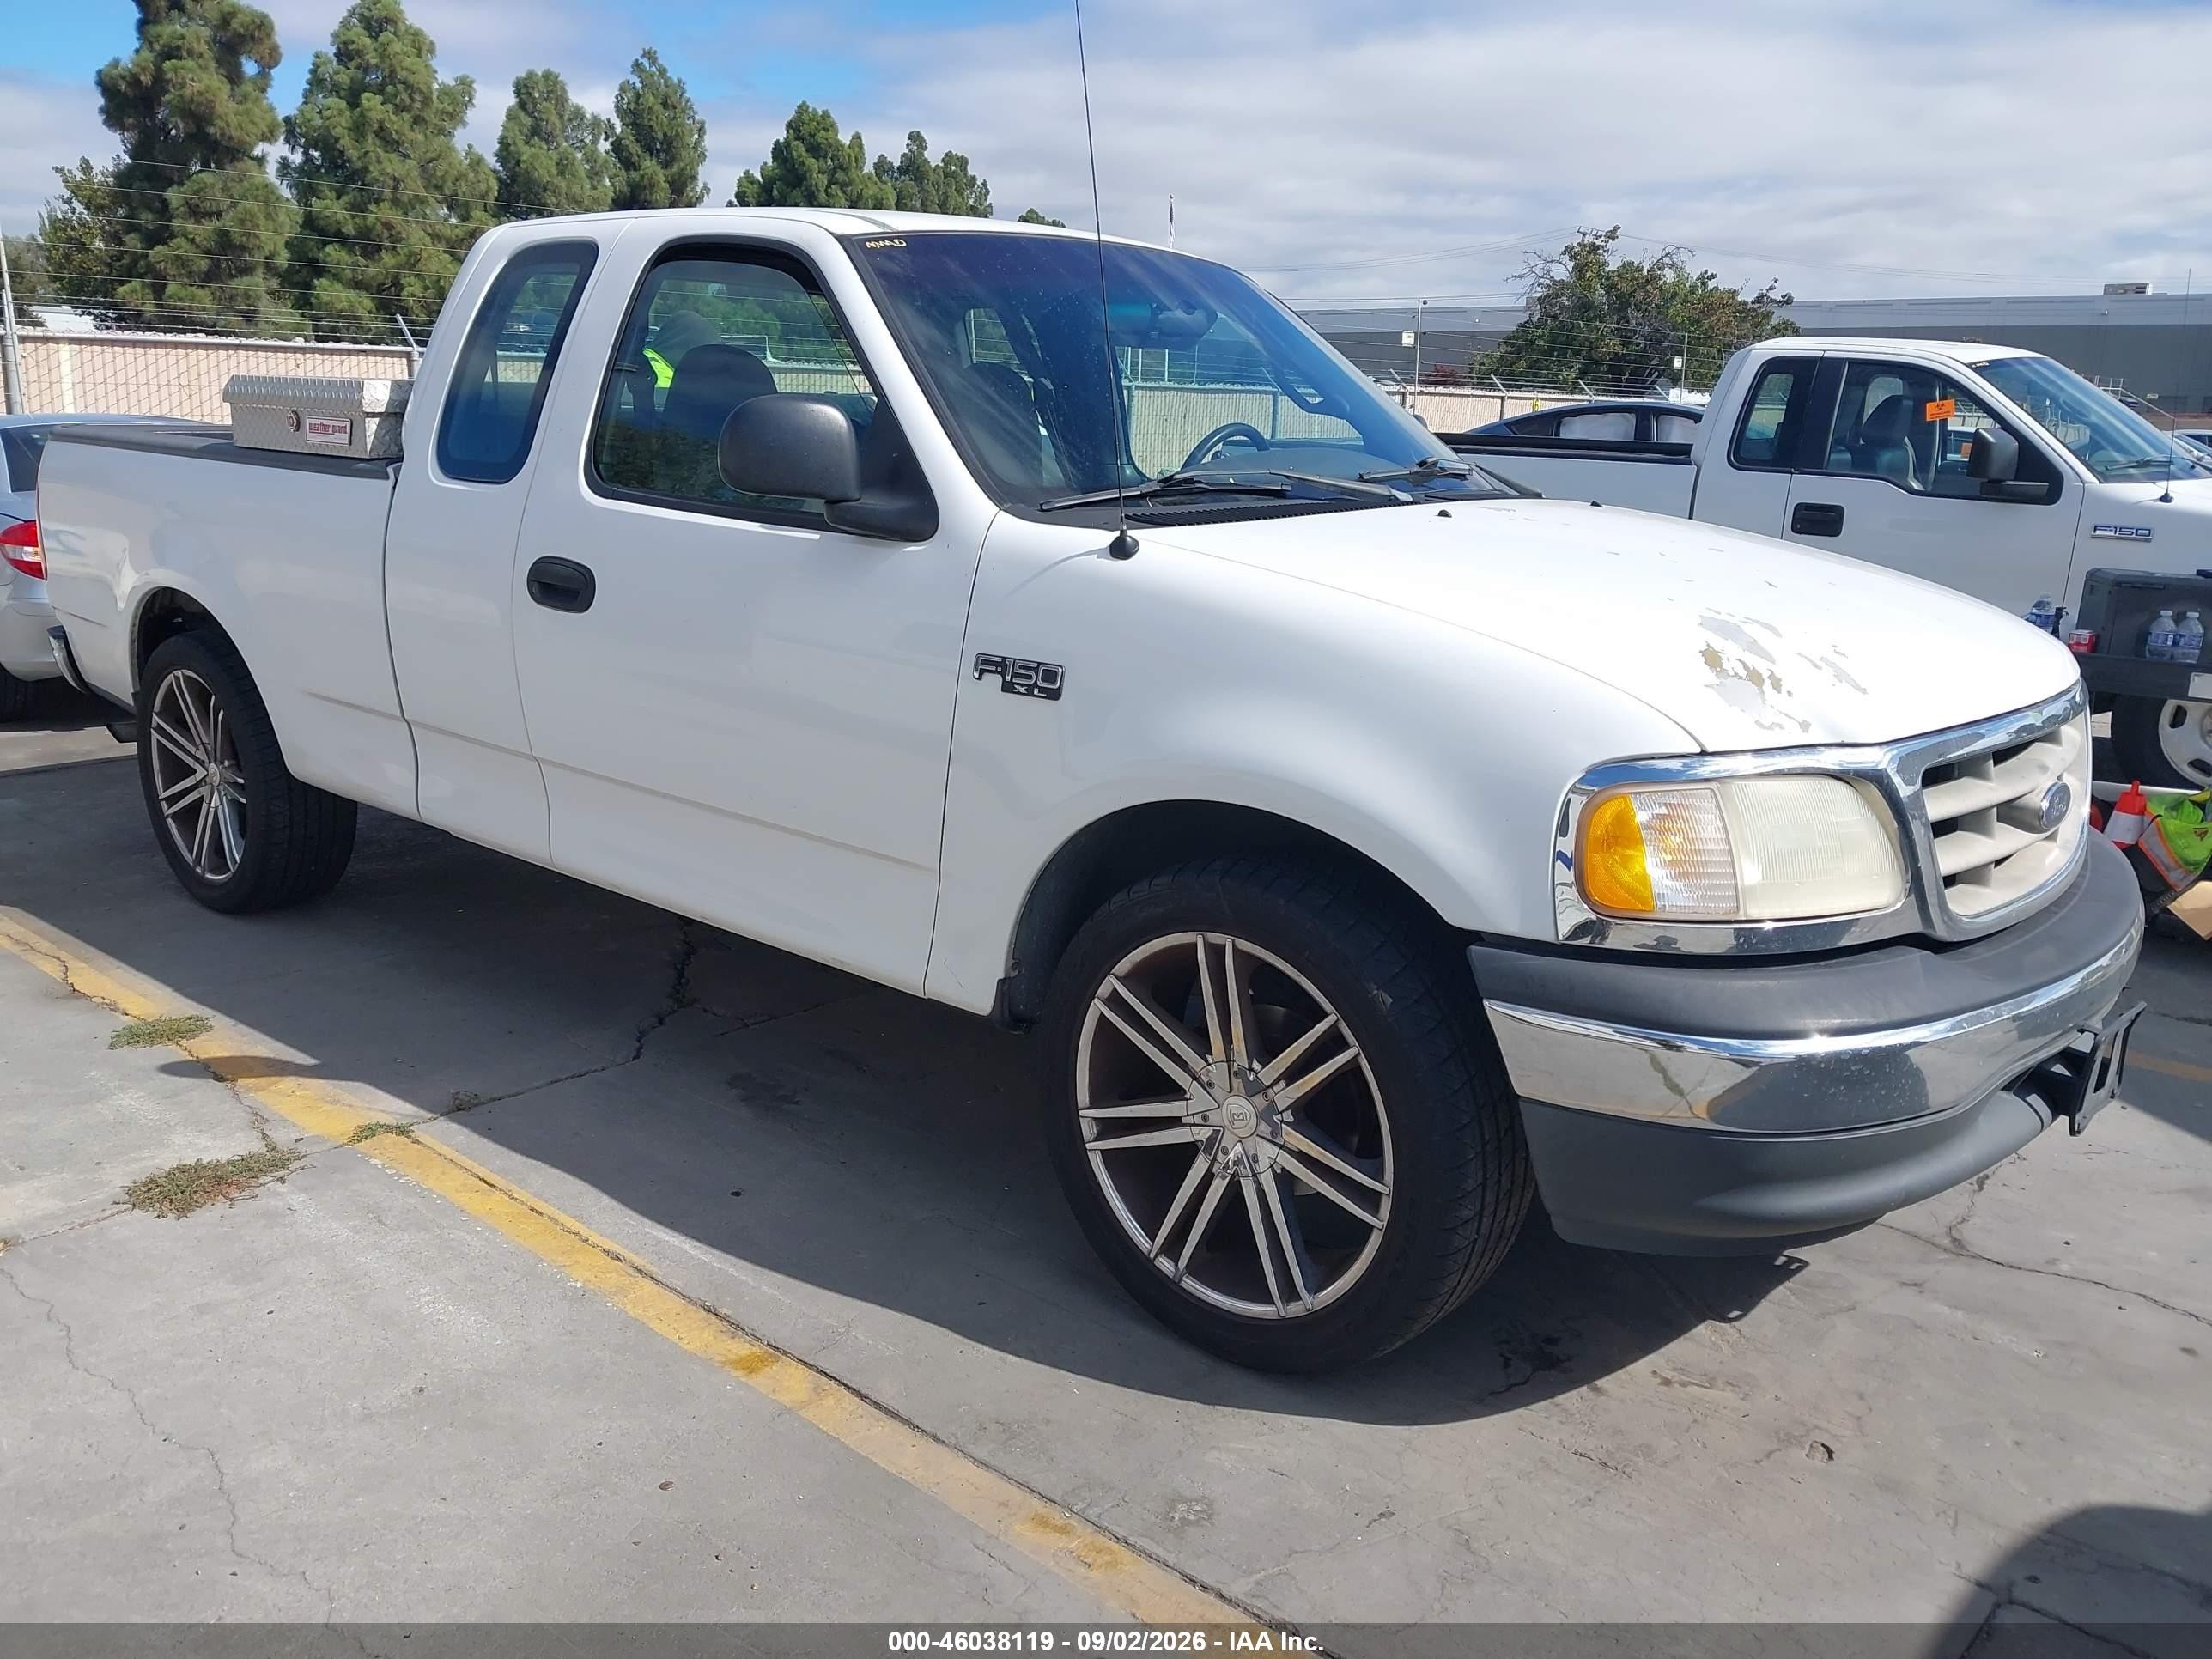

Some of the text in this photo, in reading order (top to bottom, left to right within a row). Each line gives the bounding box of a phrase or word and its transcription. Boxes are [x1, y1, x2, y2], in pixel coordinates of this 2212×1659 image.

[308, 421, 331, 433] weather
[973, 653, 1064, 690] F-150
[1013, 684, 1047, 696] XL
